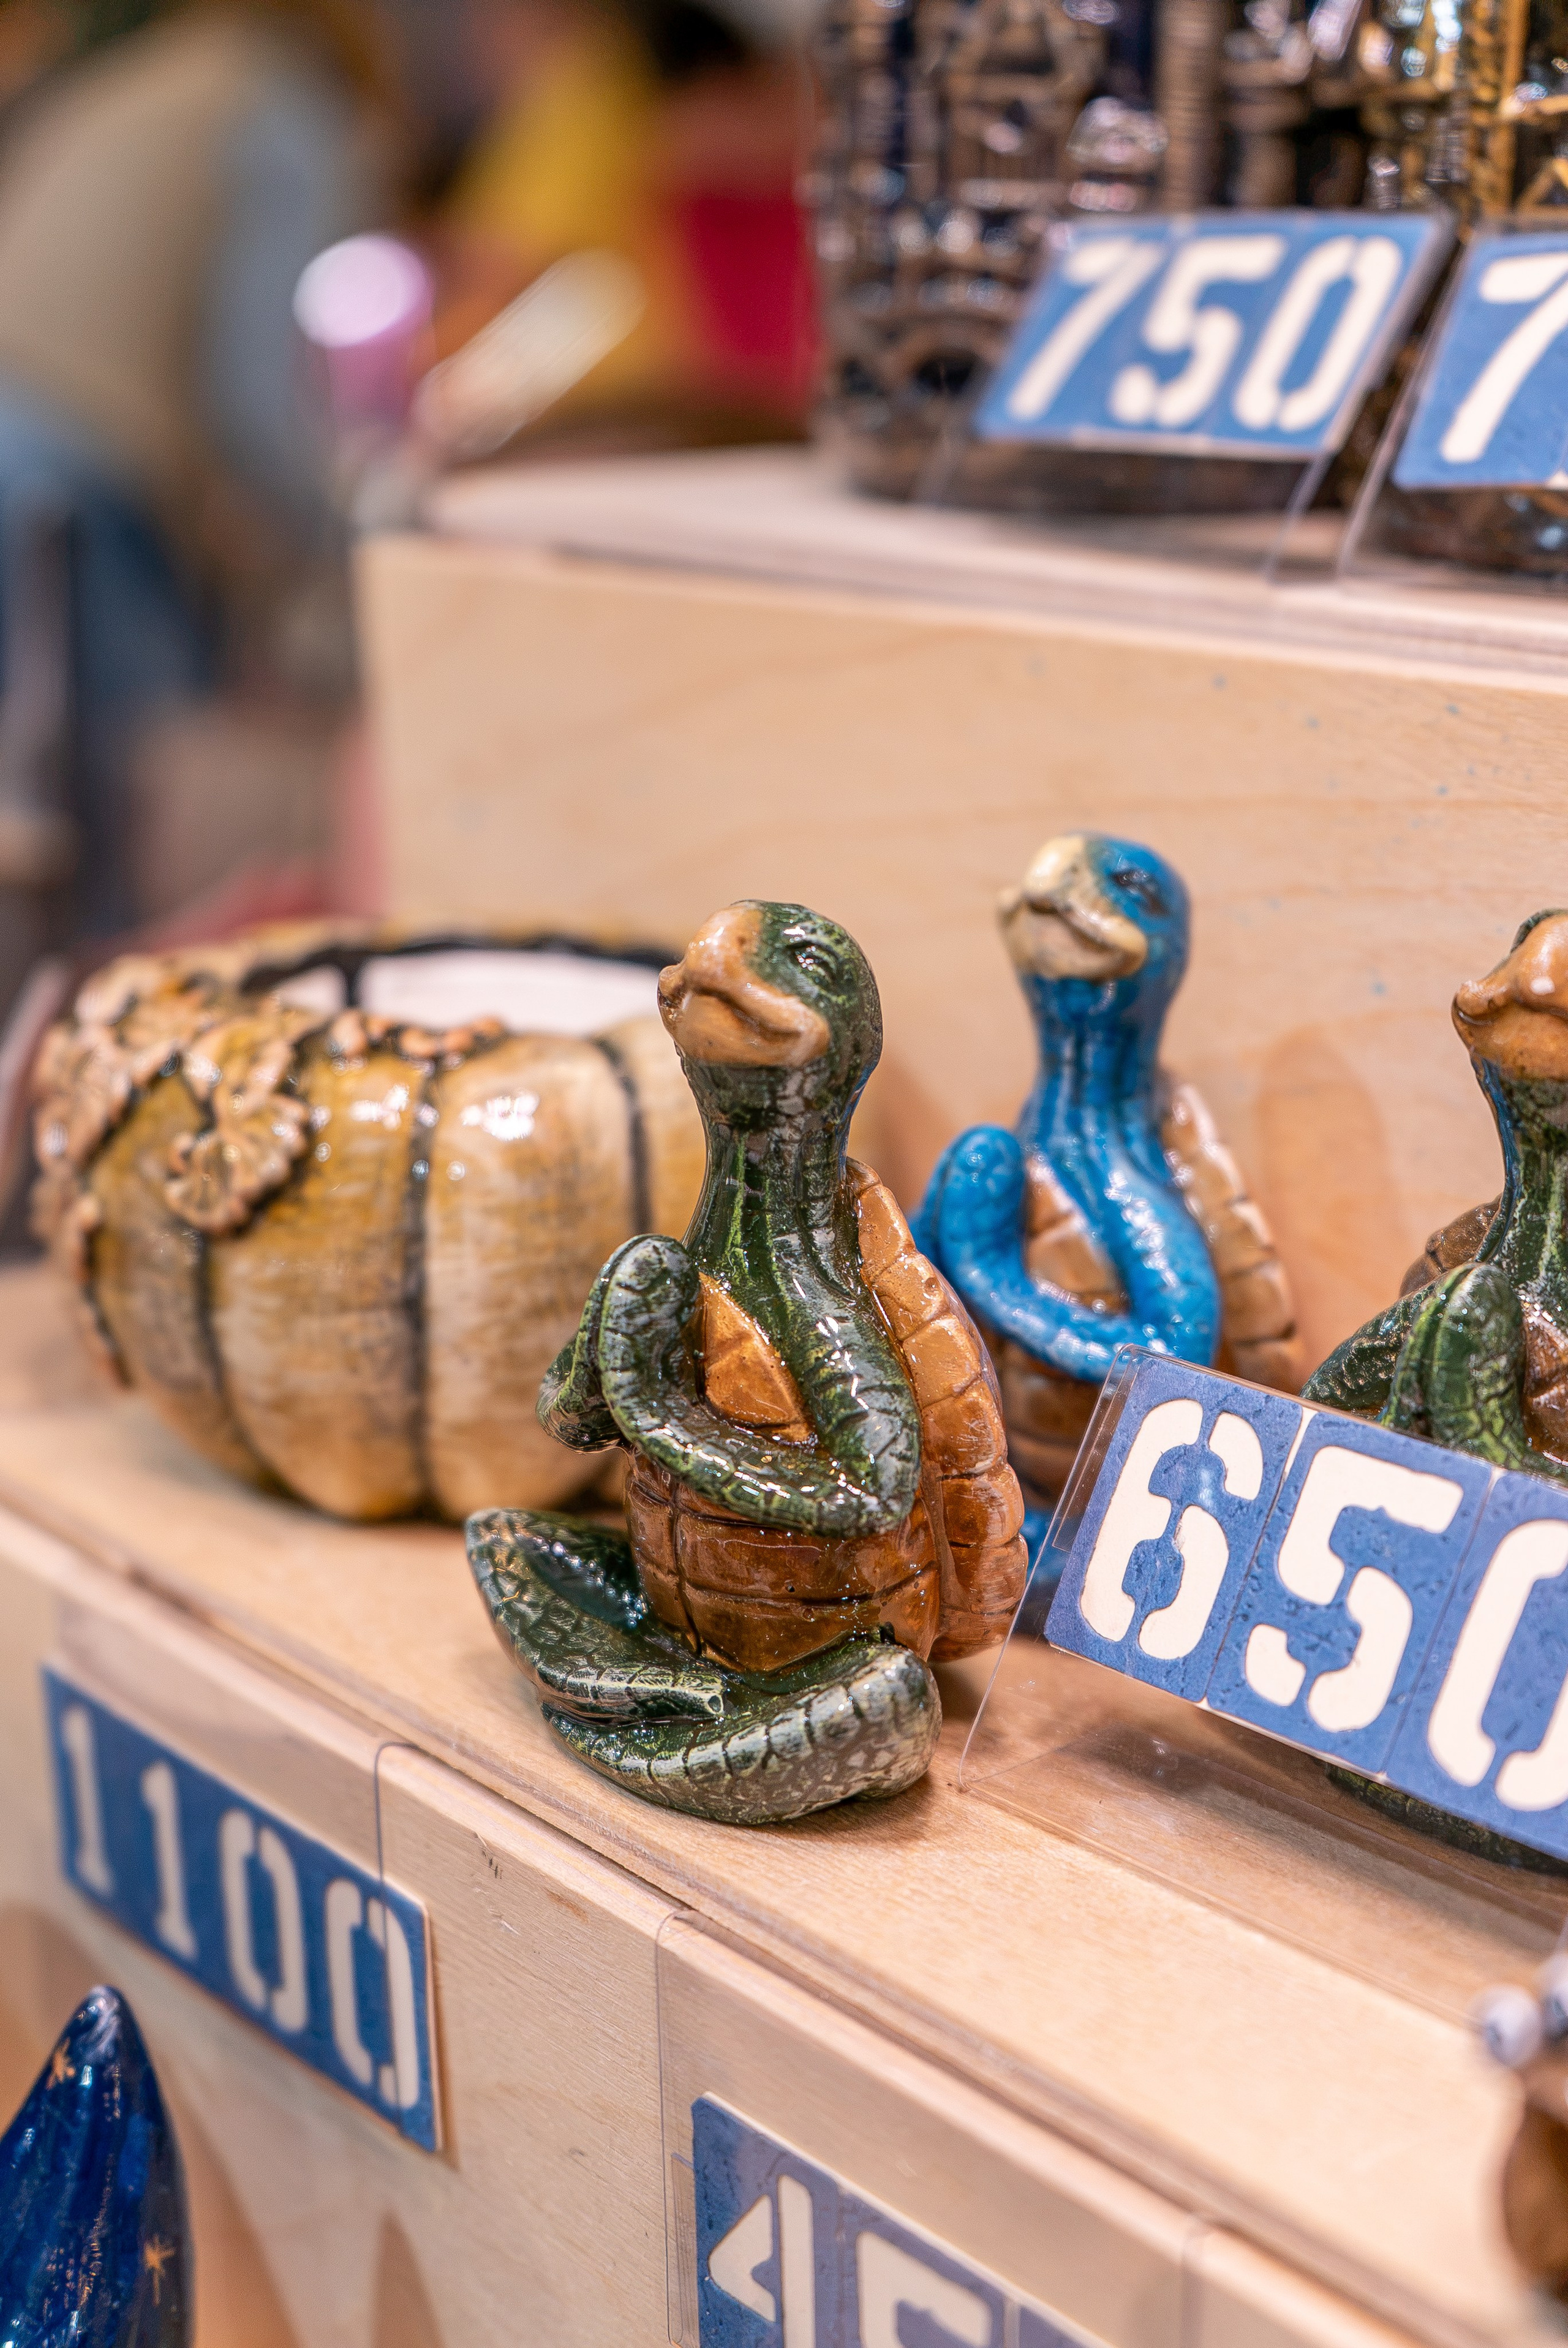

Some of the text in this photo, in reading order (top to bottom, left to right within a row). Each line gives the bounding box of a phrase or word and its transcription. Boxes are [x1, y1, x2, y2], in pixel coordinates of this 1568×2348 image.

[1012, 236, 1400, 431] 750
[1080, 1399, 1568, 1810] 650
[64, 1706, 419, 2107] 1100
